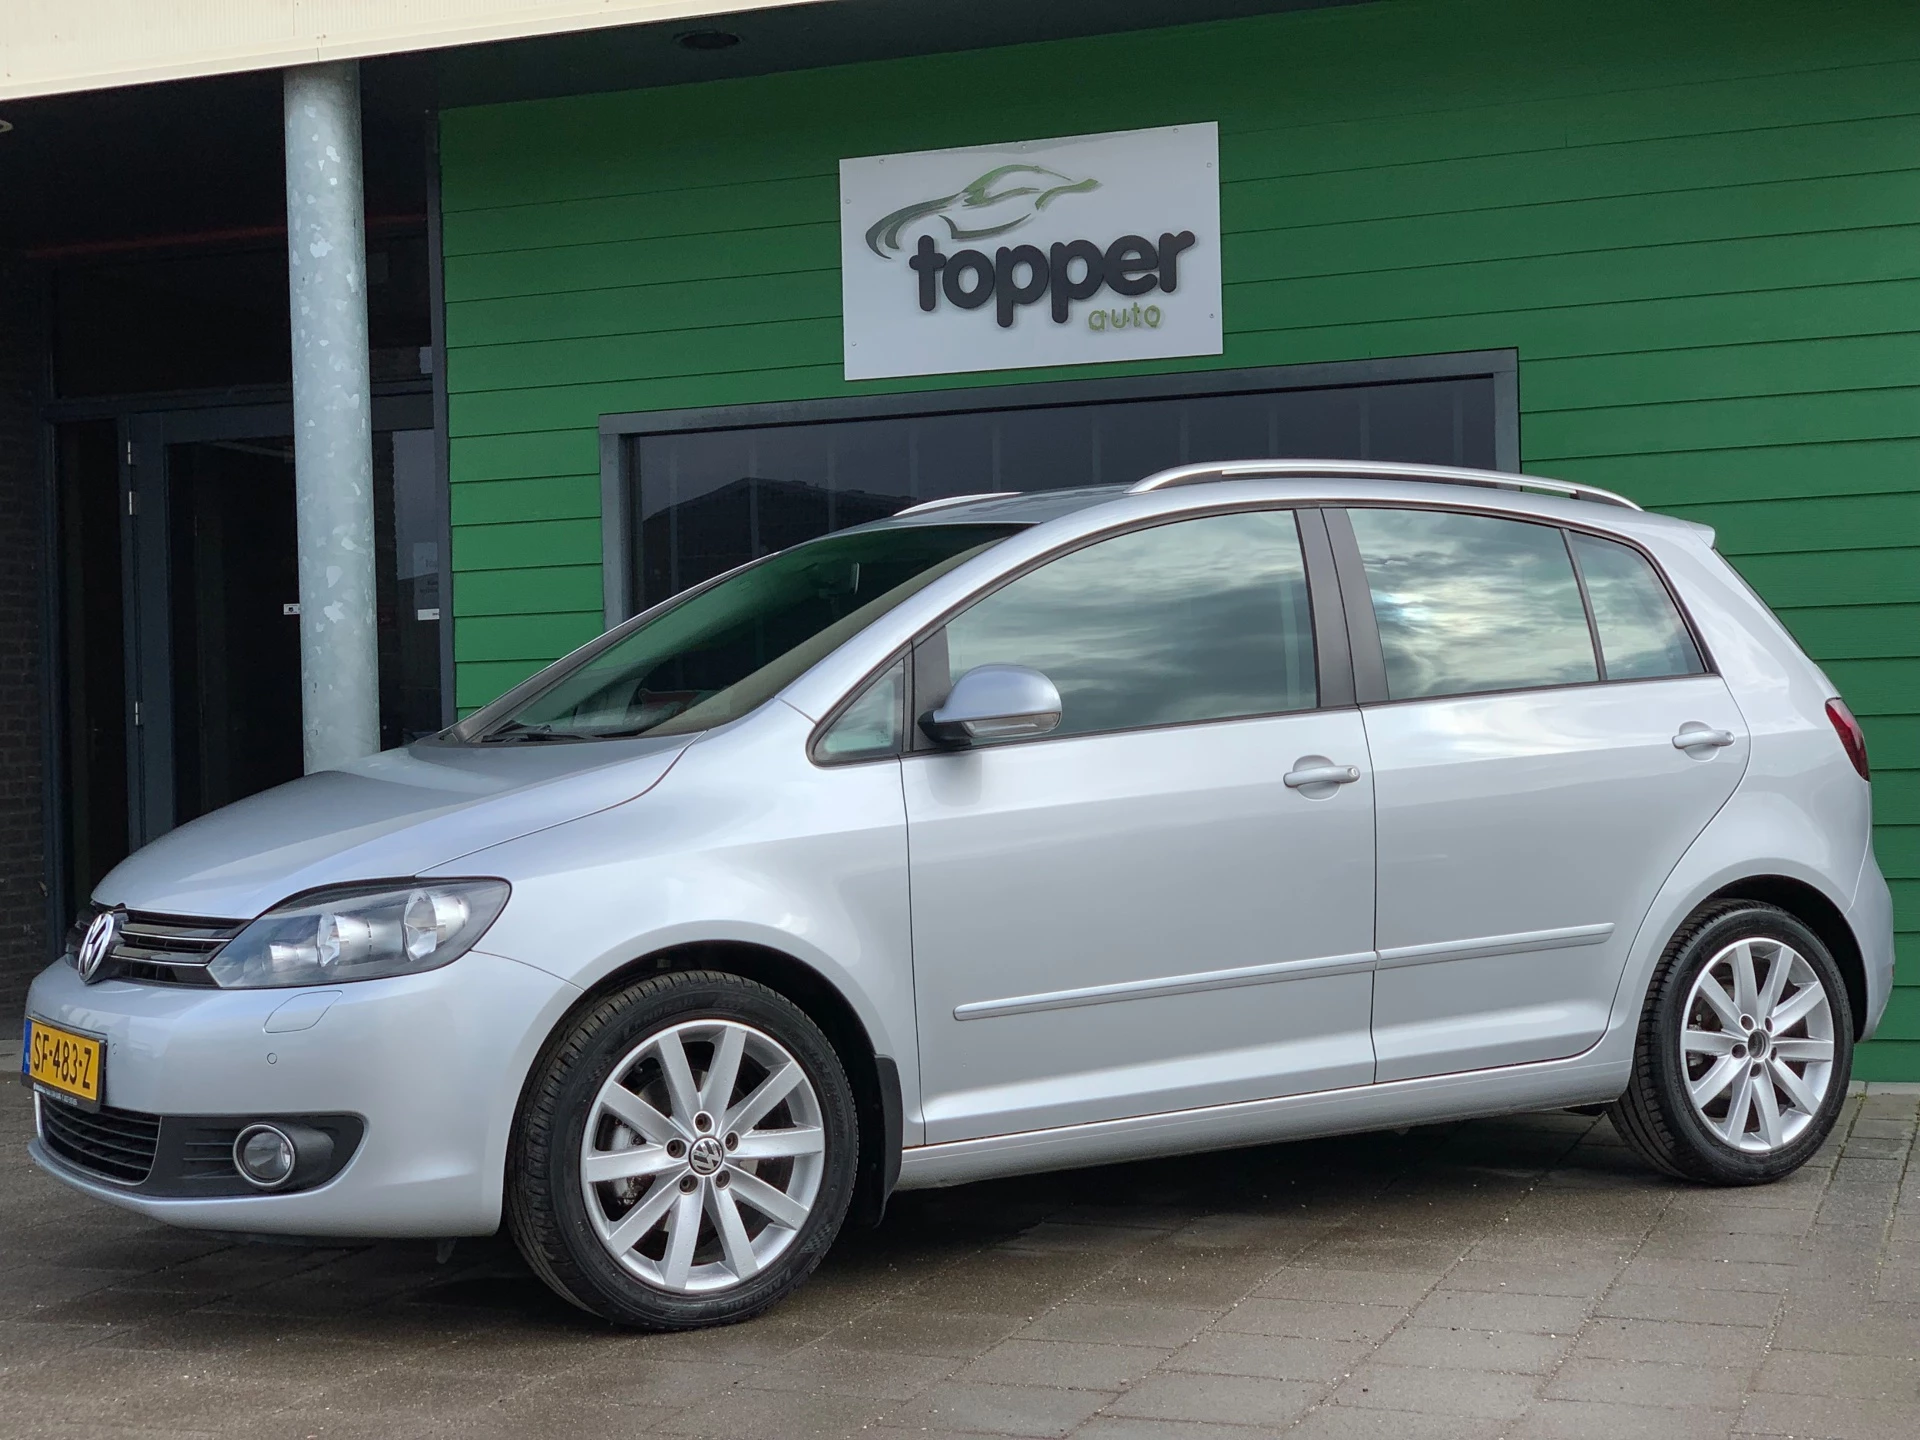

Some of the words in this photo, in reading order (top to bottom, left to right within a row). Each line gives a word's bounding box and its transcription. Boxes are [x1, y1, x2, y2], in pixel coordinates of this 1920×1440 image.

[909, 230, 1196, 328] topper
[1088, 302, 1161, 331] auto
[33, 1030, 93, 1090] SF-483-Z
